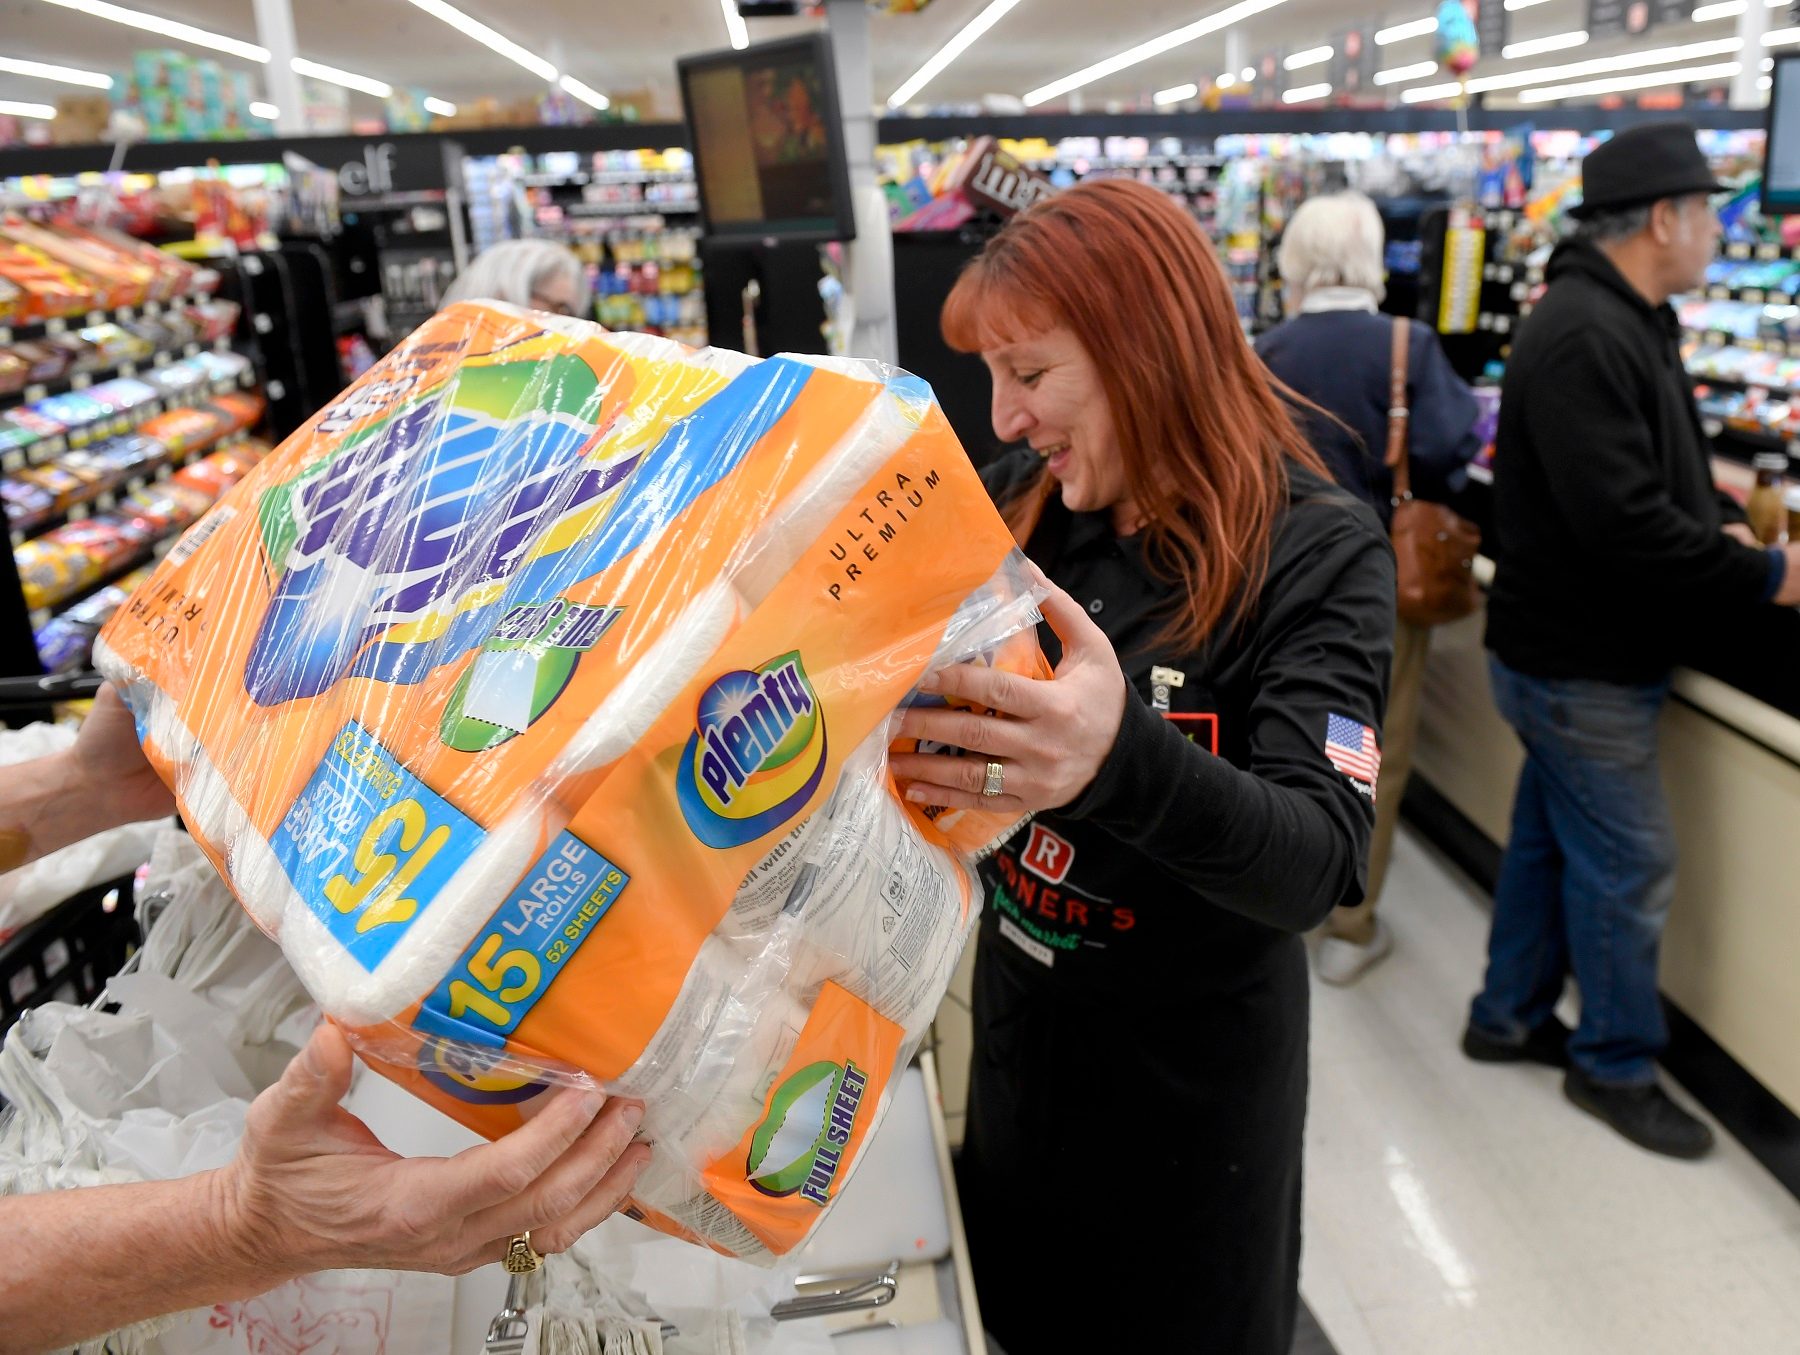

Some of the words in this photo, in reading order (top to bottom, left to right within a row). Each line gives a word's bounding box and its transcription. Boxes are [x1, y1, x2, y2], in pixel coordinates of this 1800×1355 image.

[339, 142, 397, 195] elf
[828, 469, 940, 601] PREMIUM
[829, 472, 911, 561] ULTRA
[284, 797, 348, 879] LARGE
[312, 780, 361, 834] ROLLS
[323, 798, 451, 934] 15
[502, 839, 587, 936] LARGE
[759, 840, 792, 872] with
[1035, 834, 1061, 870] R
[535, 870, 587, 929] ROLLS
[545, 939, 570, 963] 52
[564, 870, 622, 940] SHEETS
[449, 933, 541, 1026] 15
[801, 1146, 842, 1206] FULL
[826, 1063, 867, 1147] SHEET
